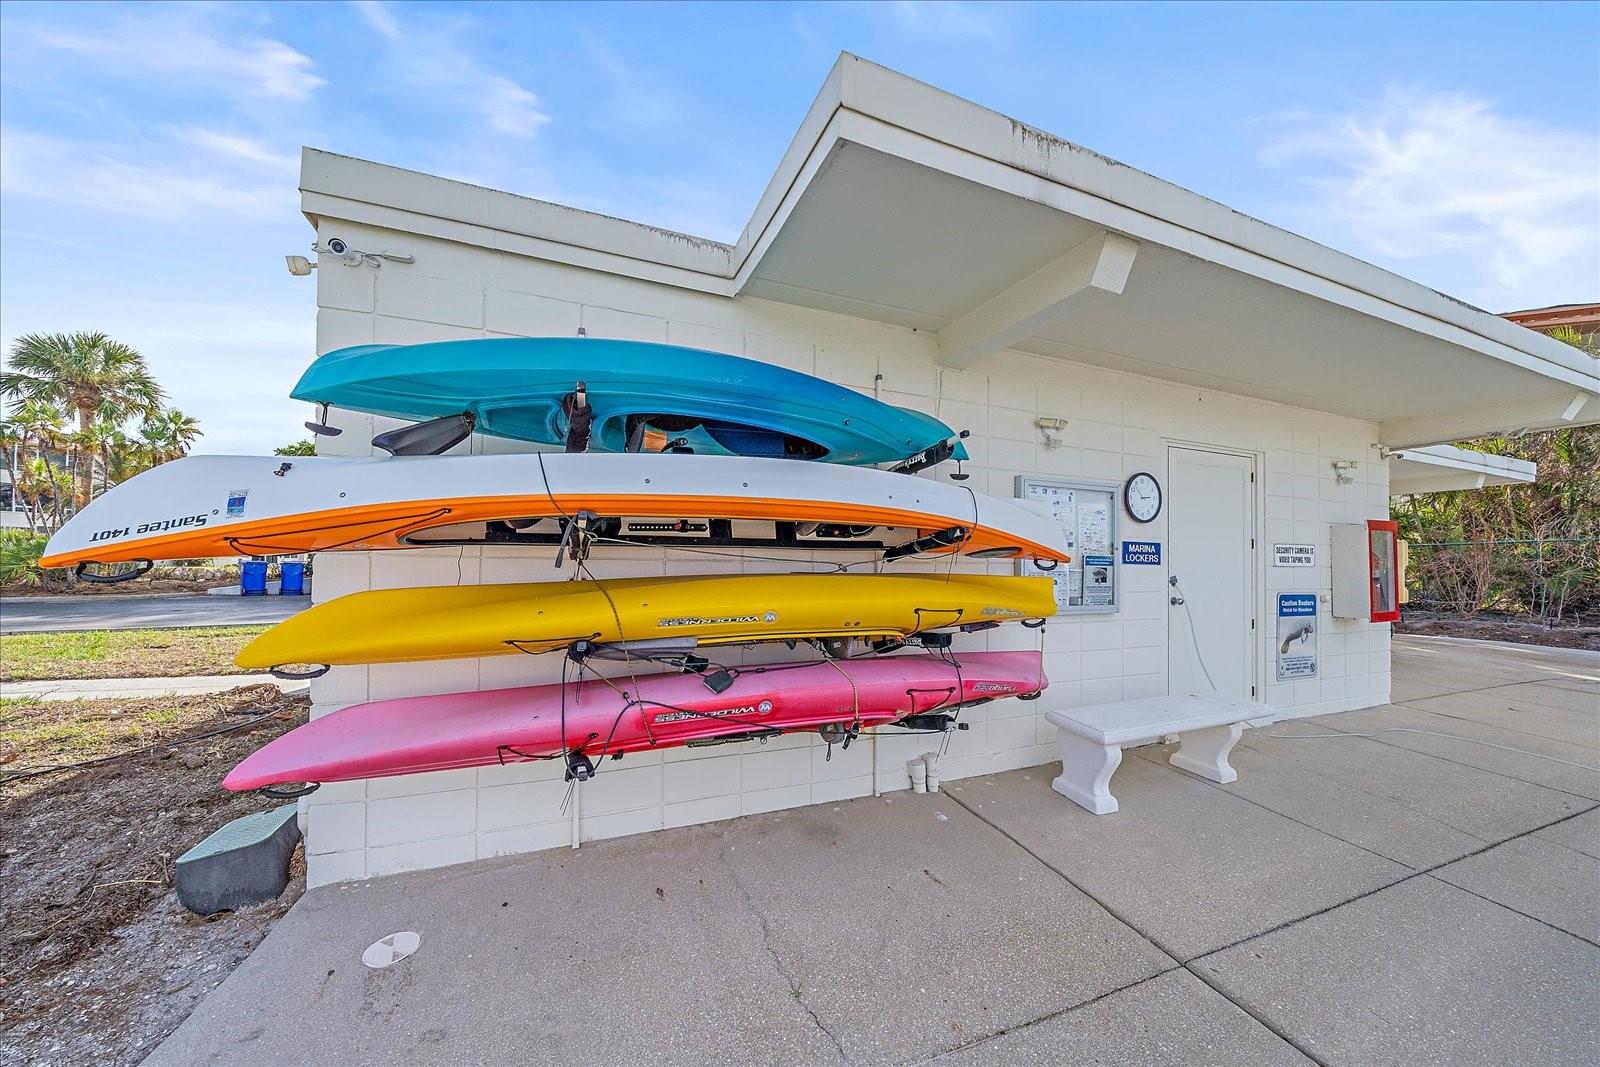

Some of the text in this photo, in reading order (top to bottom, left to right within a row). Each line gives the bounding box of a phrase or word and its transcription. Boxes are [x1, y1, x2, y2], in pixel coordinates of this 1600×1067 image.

[89, 514, 208, 542] Santee 140T
[1128, 544, 1156, 553] MARINA
[1125, 553, 1159, 563] LOCKERS
[655, 706, 755, 723] WILDENESS
